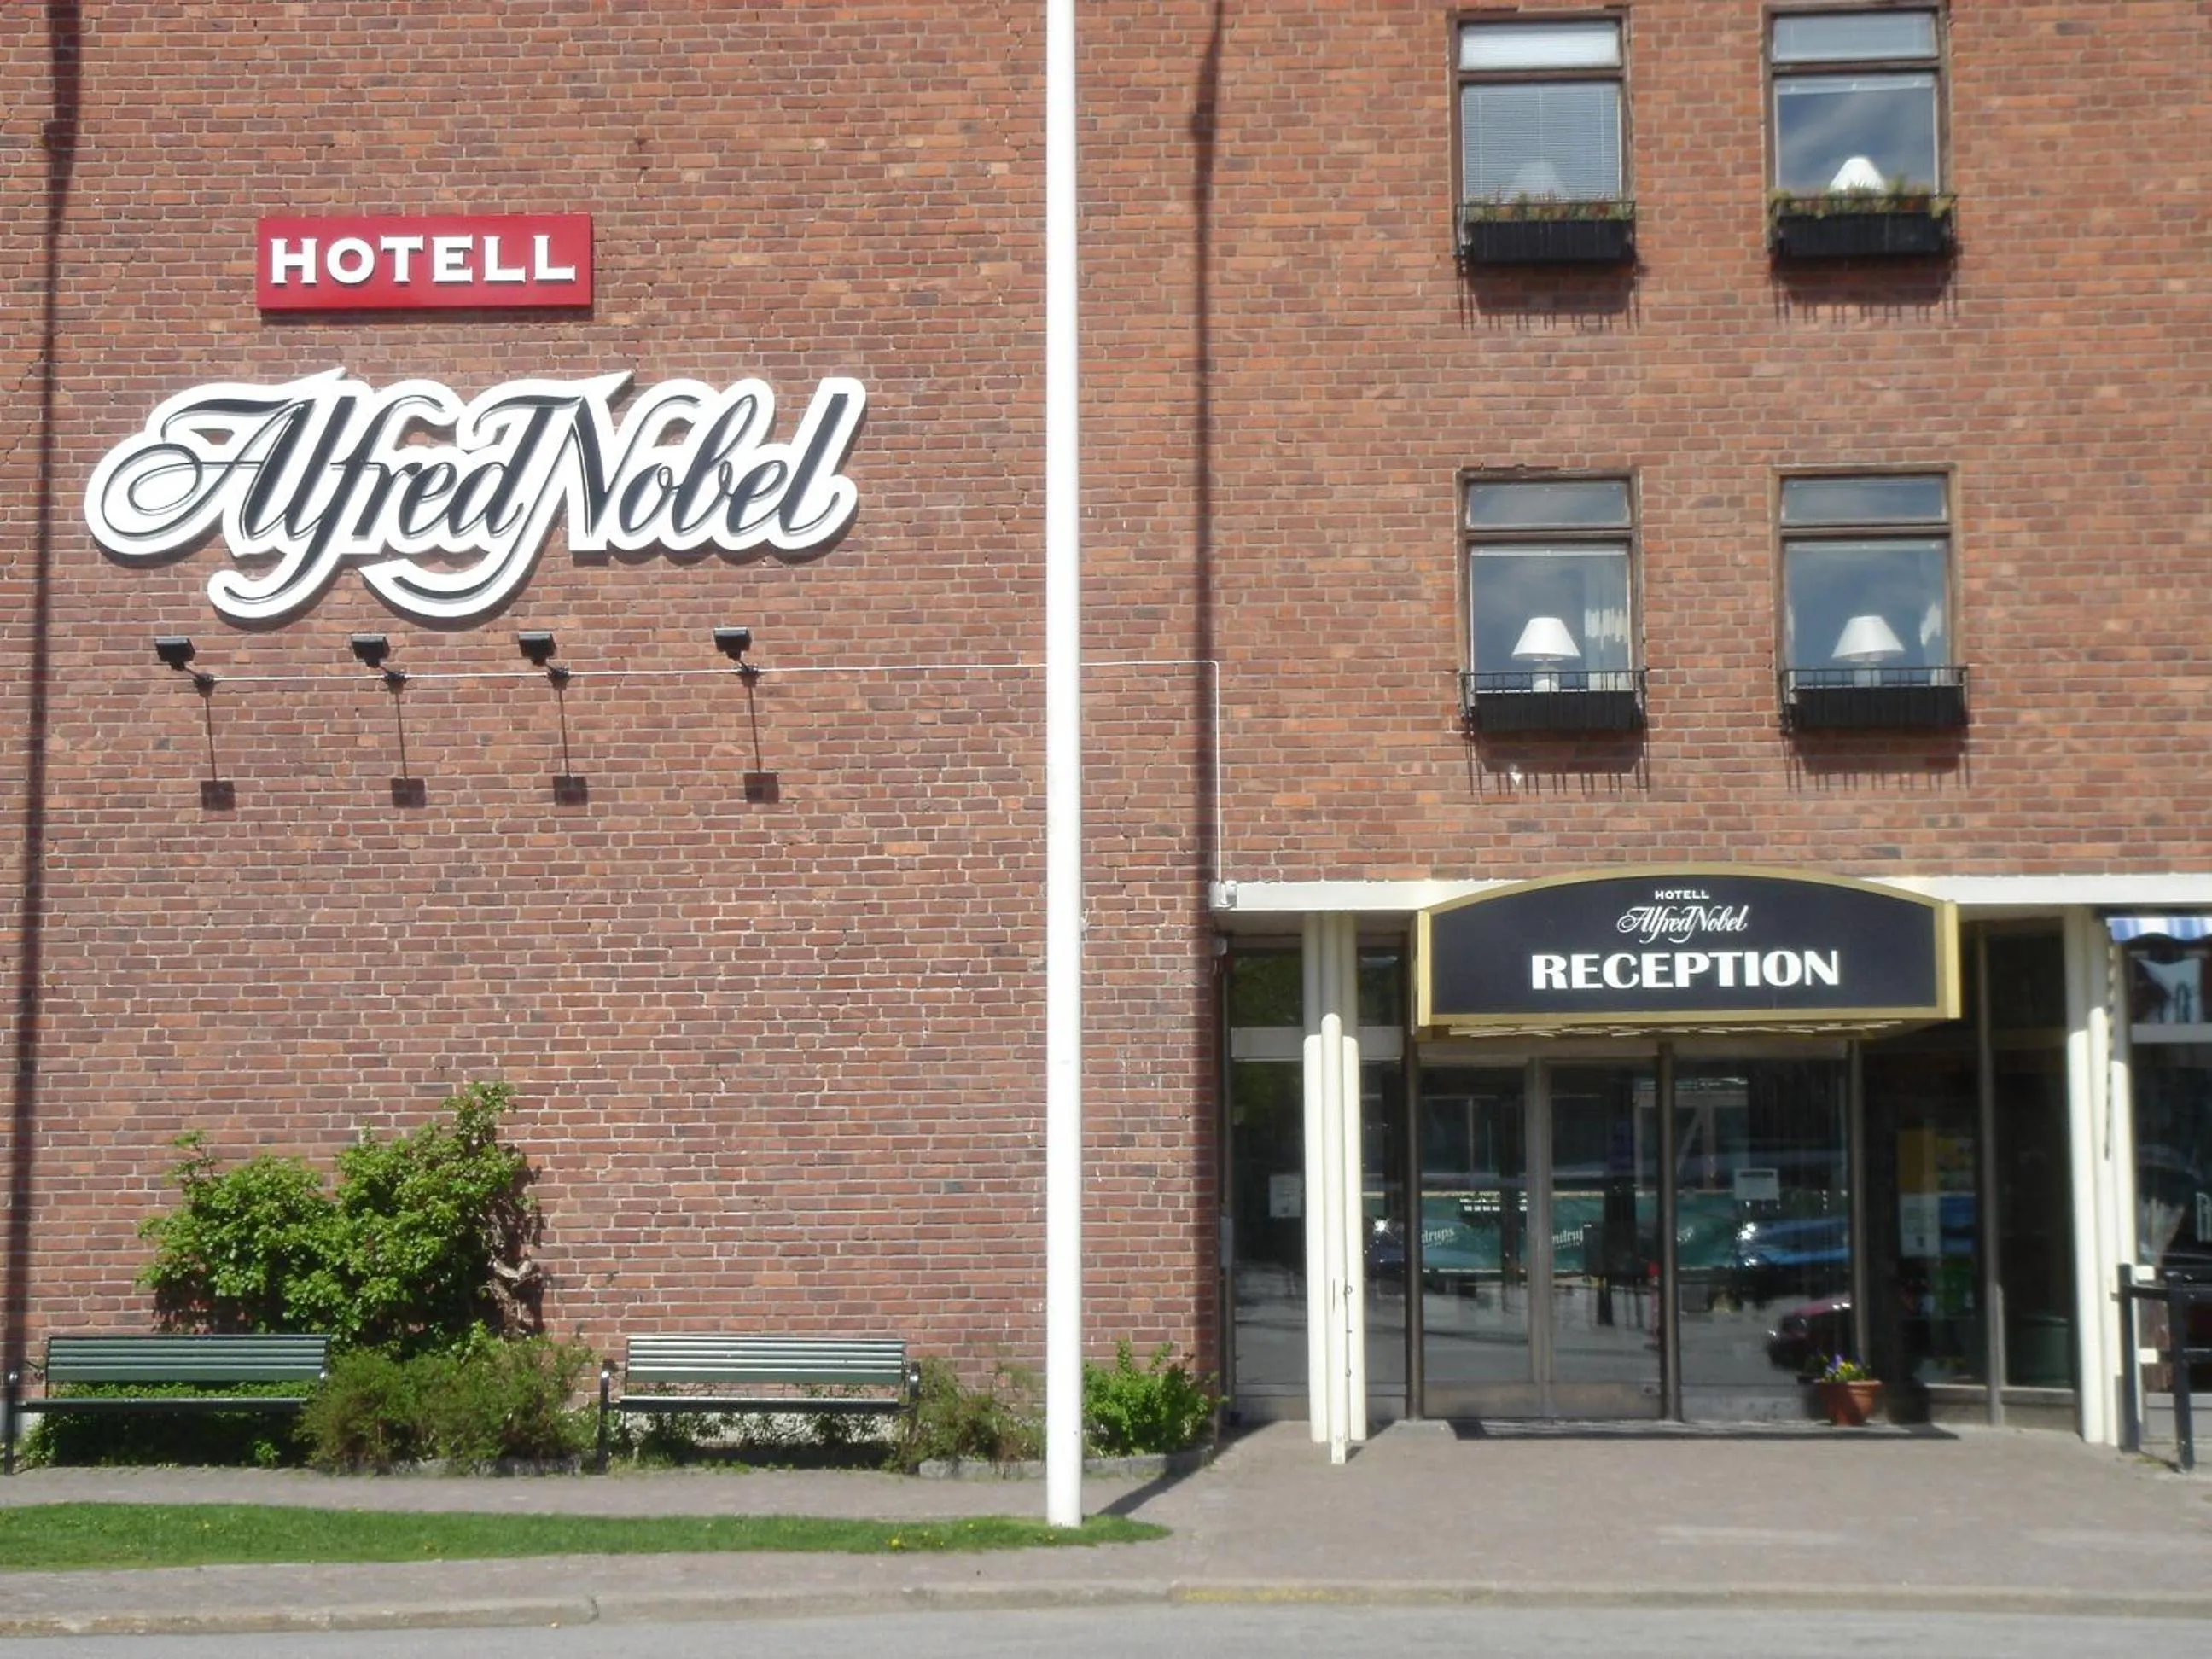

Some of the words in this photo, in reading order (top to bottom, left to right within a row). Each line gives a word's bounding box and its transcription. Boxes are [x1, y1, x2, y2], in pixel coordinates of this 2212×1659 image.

[270, 234, 576, 285] HOTELL
[84, 369, 568, 617] Alfred
[435, 370, 865, 616] Nobel
[1654, 890, 1710, 900] HOTELL
[1617, 905, 1693, 943] Alfred
[1673, 905, 1749, 942] Nobel
[1531, 950, 1840, 989] RECEPTION
